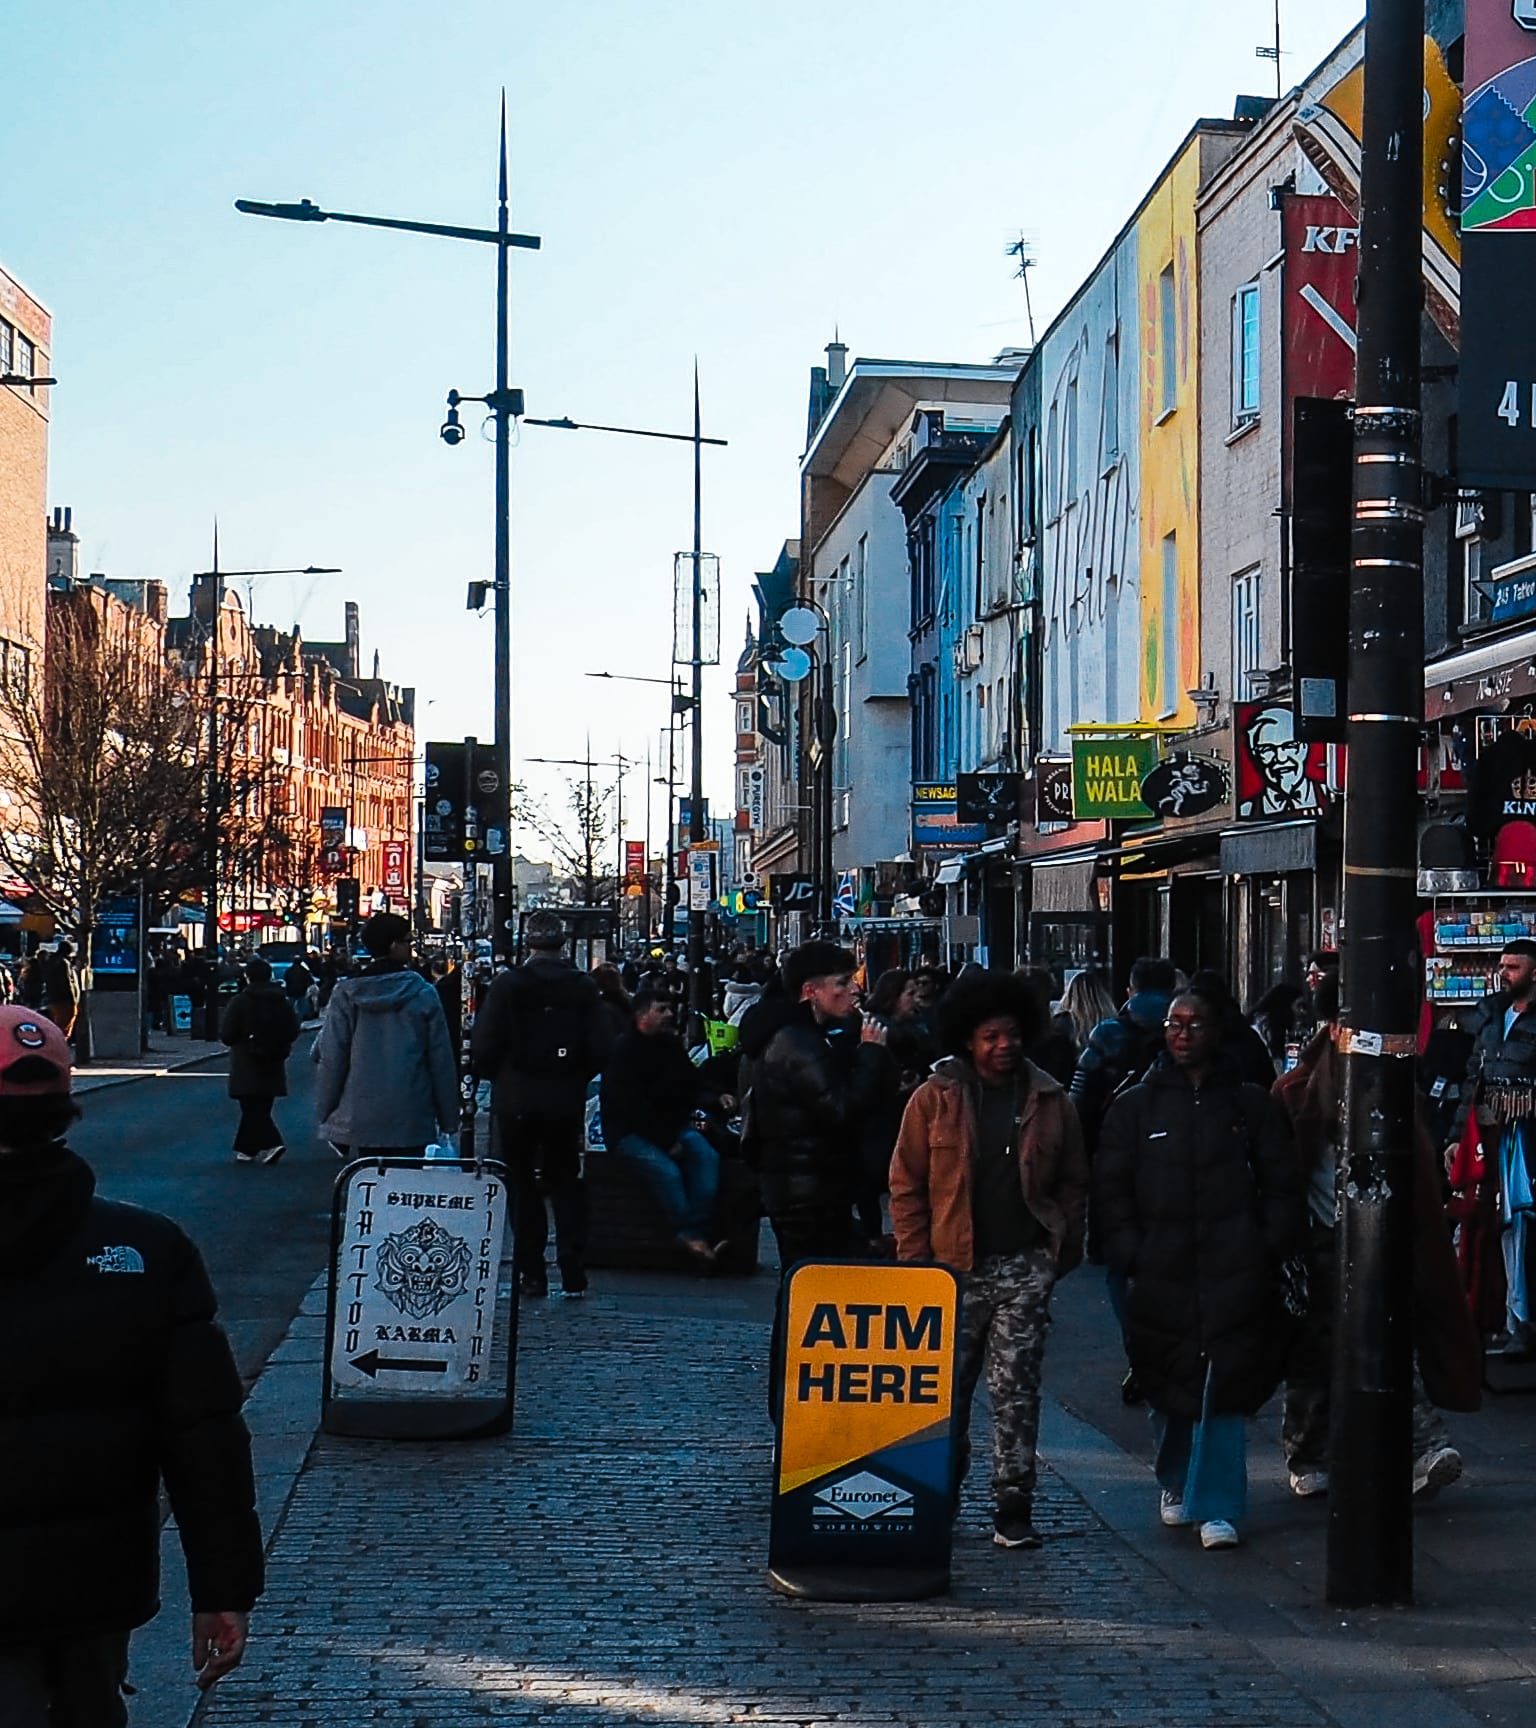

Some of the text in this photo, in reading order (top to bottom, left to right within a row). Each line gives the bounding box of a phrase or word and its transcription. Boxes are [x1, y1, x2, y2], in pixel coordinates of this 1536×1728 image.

[1300, 225, 1361, 254] KF
[1497, 380, 1521, 428] 4
[1086, 754, 1138, 778] HALA
[1085, 780, 1142, 803] WALA
[386, 1191, 476, 1211] SUPREME
[344, 1181, 378, 1354] TATTOO
[464, 1183, 499, 1384] PIERCING
[374, 1324, 458, 1345] KARMA
[800, 1303, 943, 1352] ATM
[797, 1362, 940, 1404] HERE
[830, 1486, 900, 1504] Euronet
